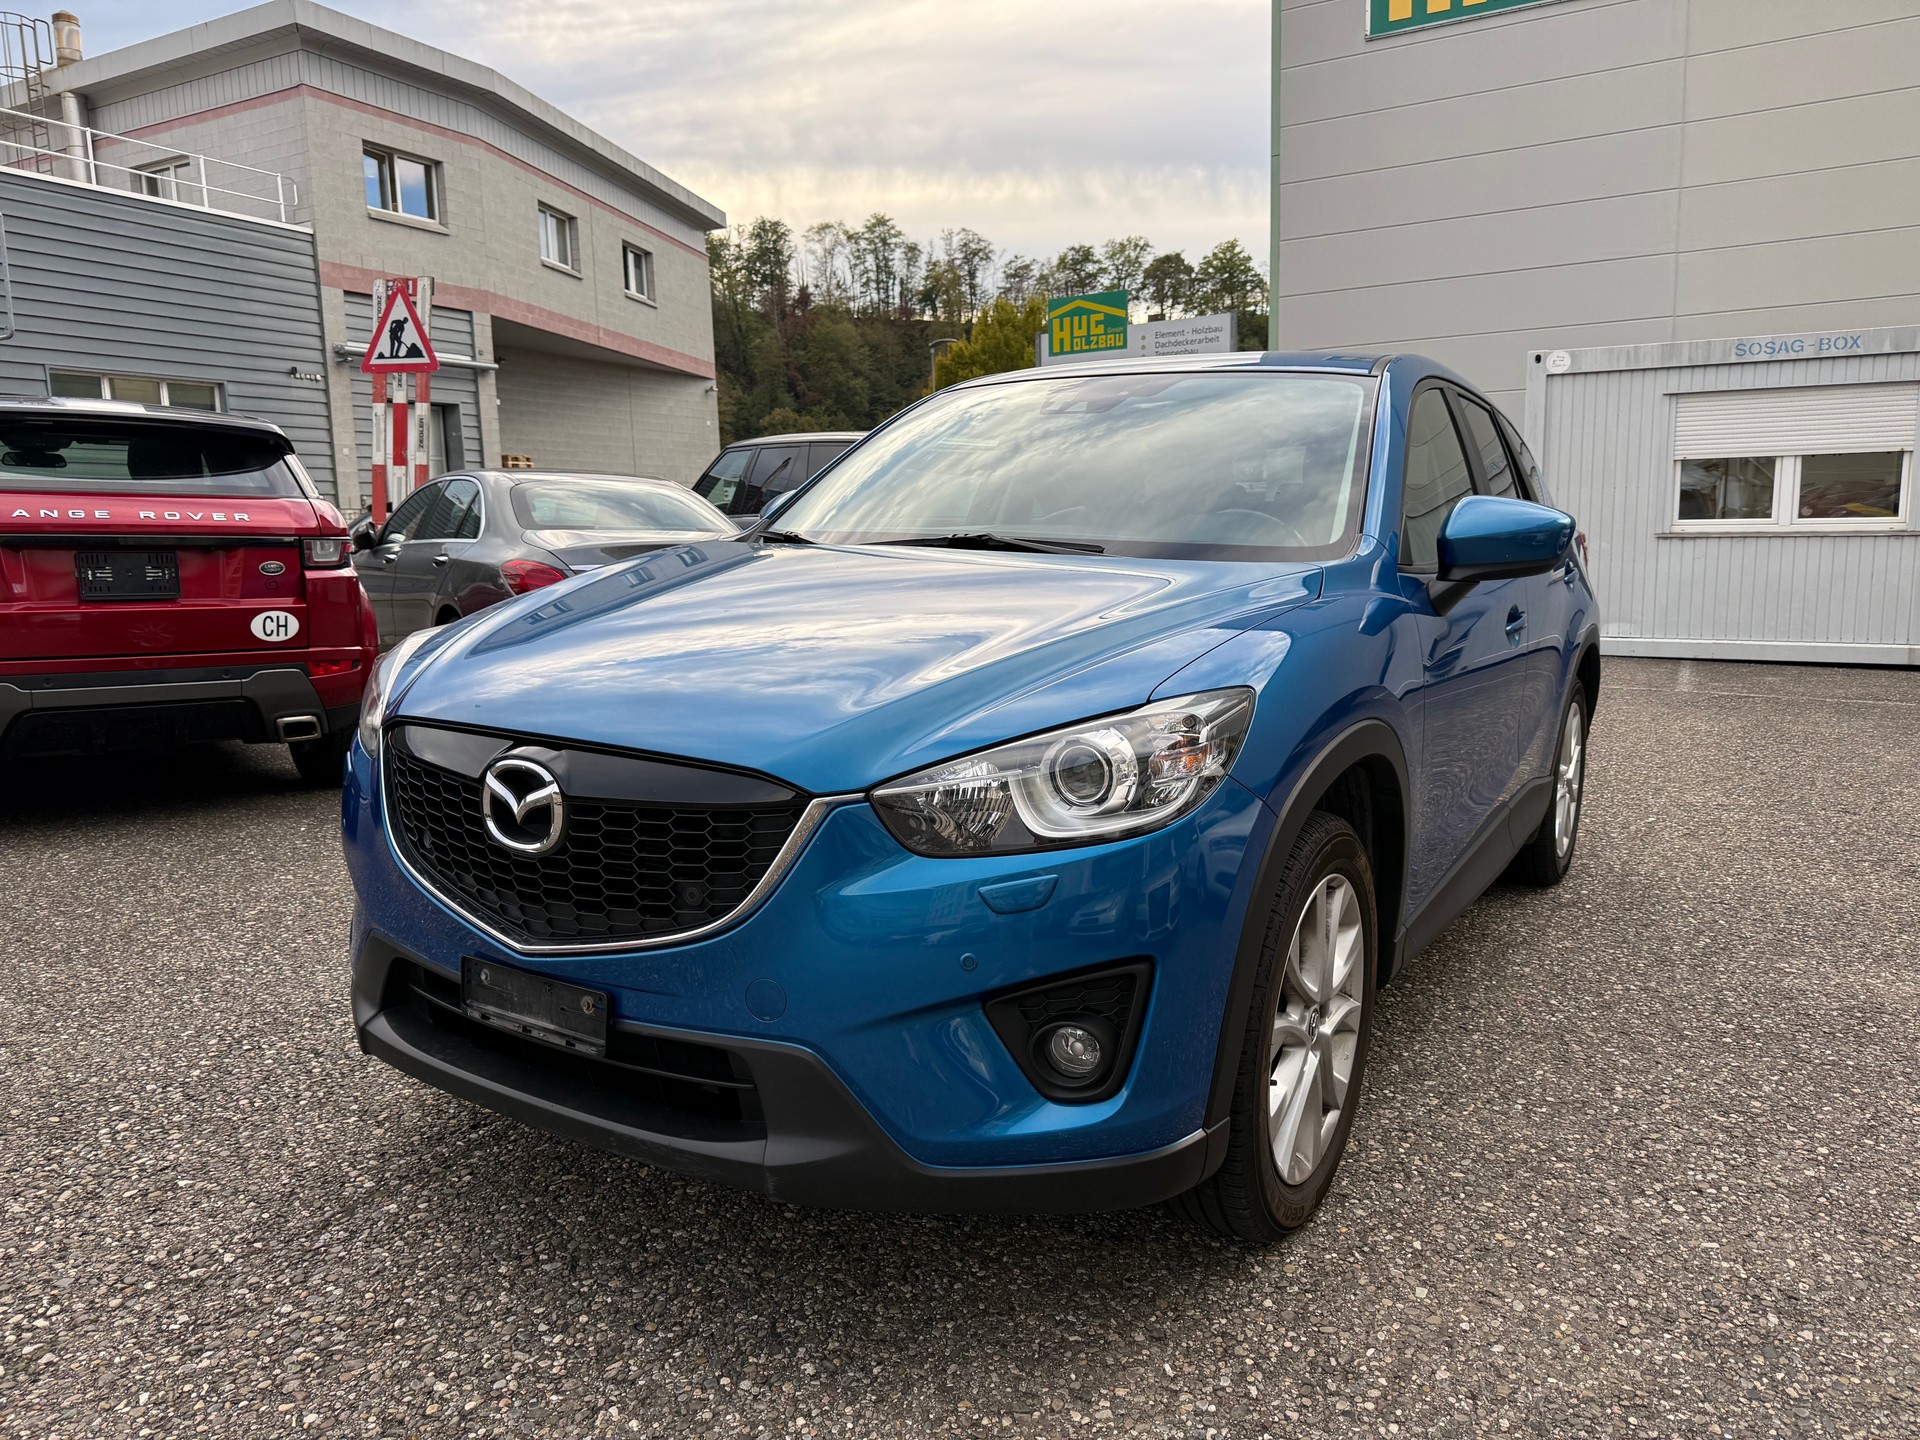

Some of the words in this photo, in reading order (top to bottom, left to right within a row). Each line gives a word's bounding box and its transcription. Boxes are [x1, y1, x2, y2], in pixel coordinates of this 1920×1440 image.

[1155, 329, 1185, 340] Element
[1191, 326, 1223, 336] Holzbau
[1154, 335, 1220, 349] Dachdeckerarbeit
[11, 509, 110, 519] ANGE
[138, 510, 251, 522] ROVER
[262, 615, 289, 637] CH
